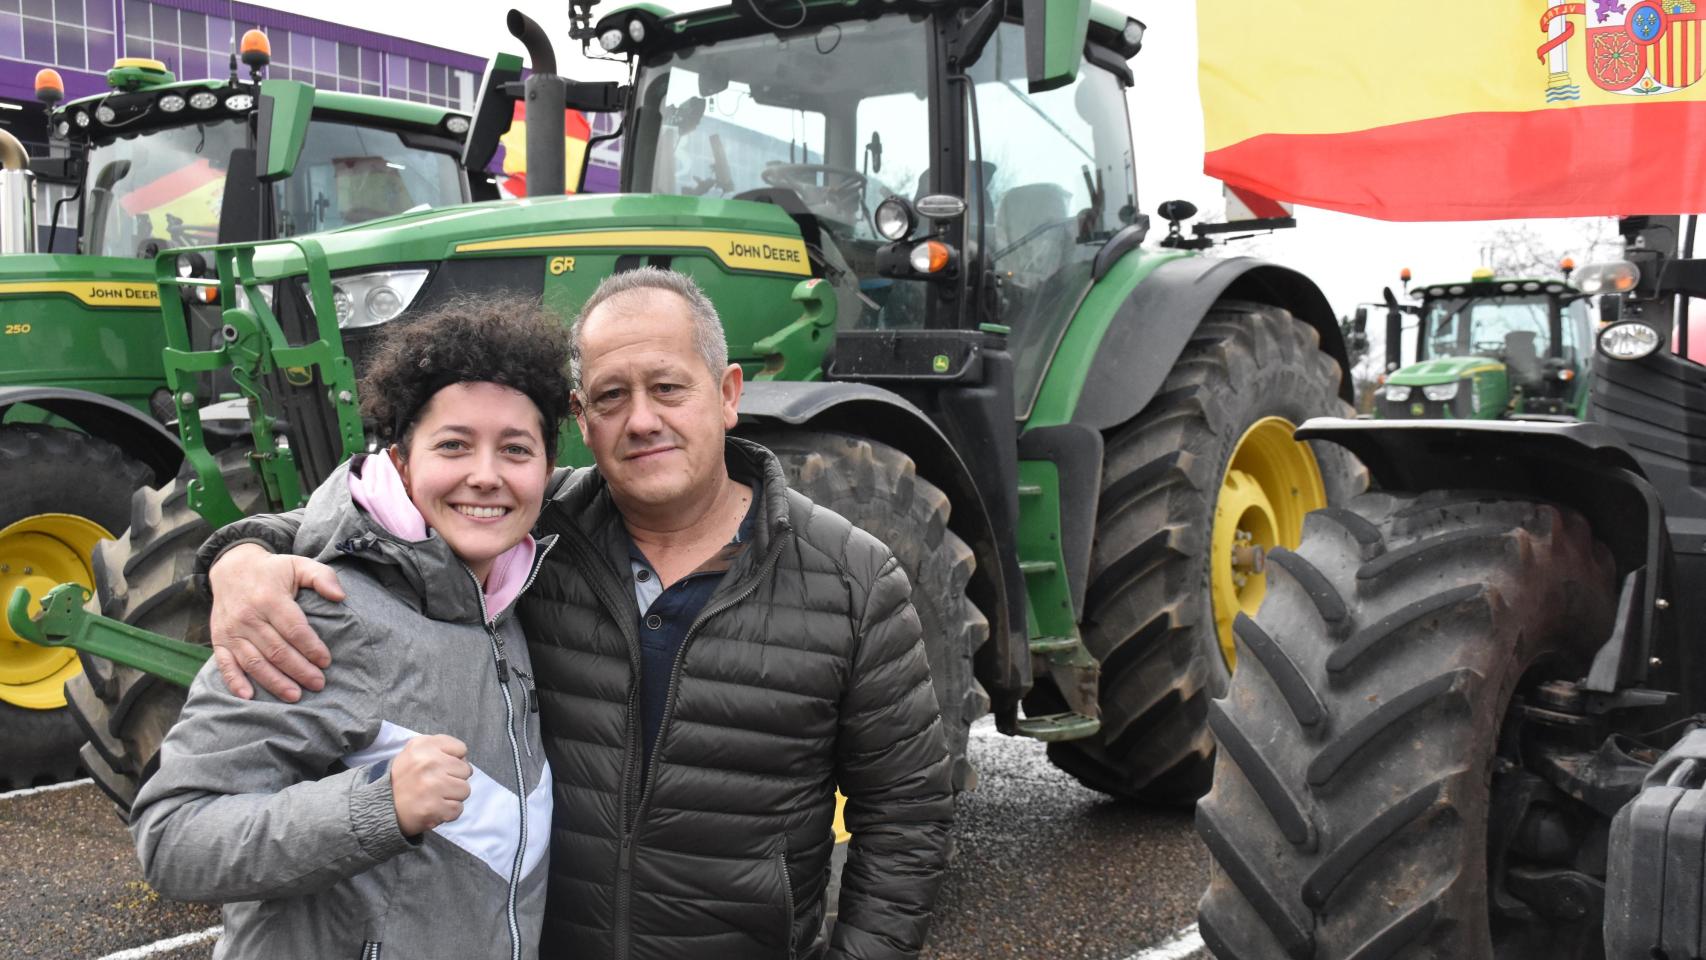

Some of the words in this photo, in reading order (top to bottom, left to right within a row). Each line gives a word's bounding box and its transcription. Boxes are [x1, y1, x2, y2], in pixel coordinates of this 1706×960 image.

[728, 240, 761, 259] JOHN
[762, 244, 801, 263] DEERE
[550, 256, 576, 275] 6R
[89, 287, 123, 299] JOHN
[125, 287, 159, 300] DEER
[4, 323, 32, 335] 250
